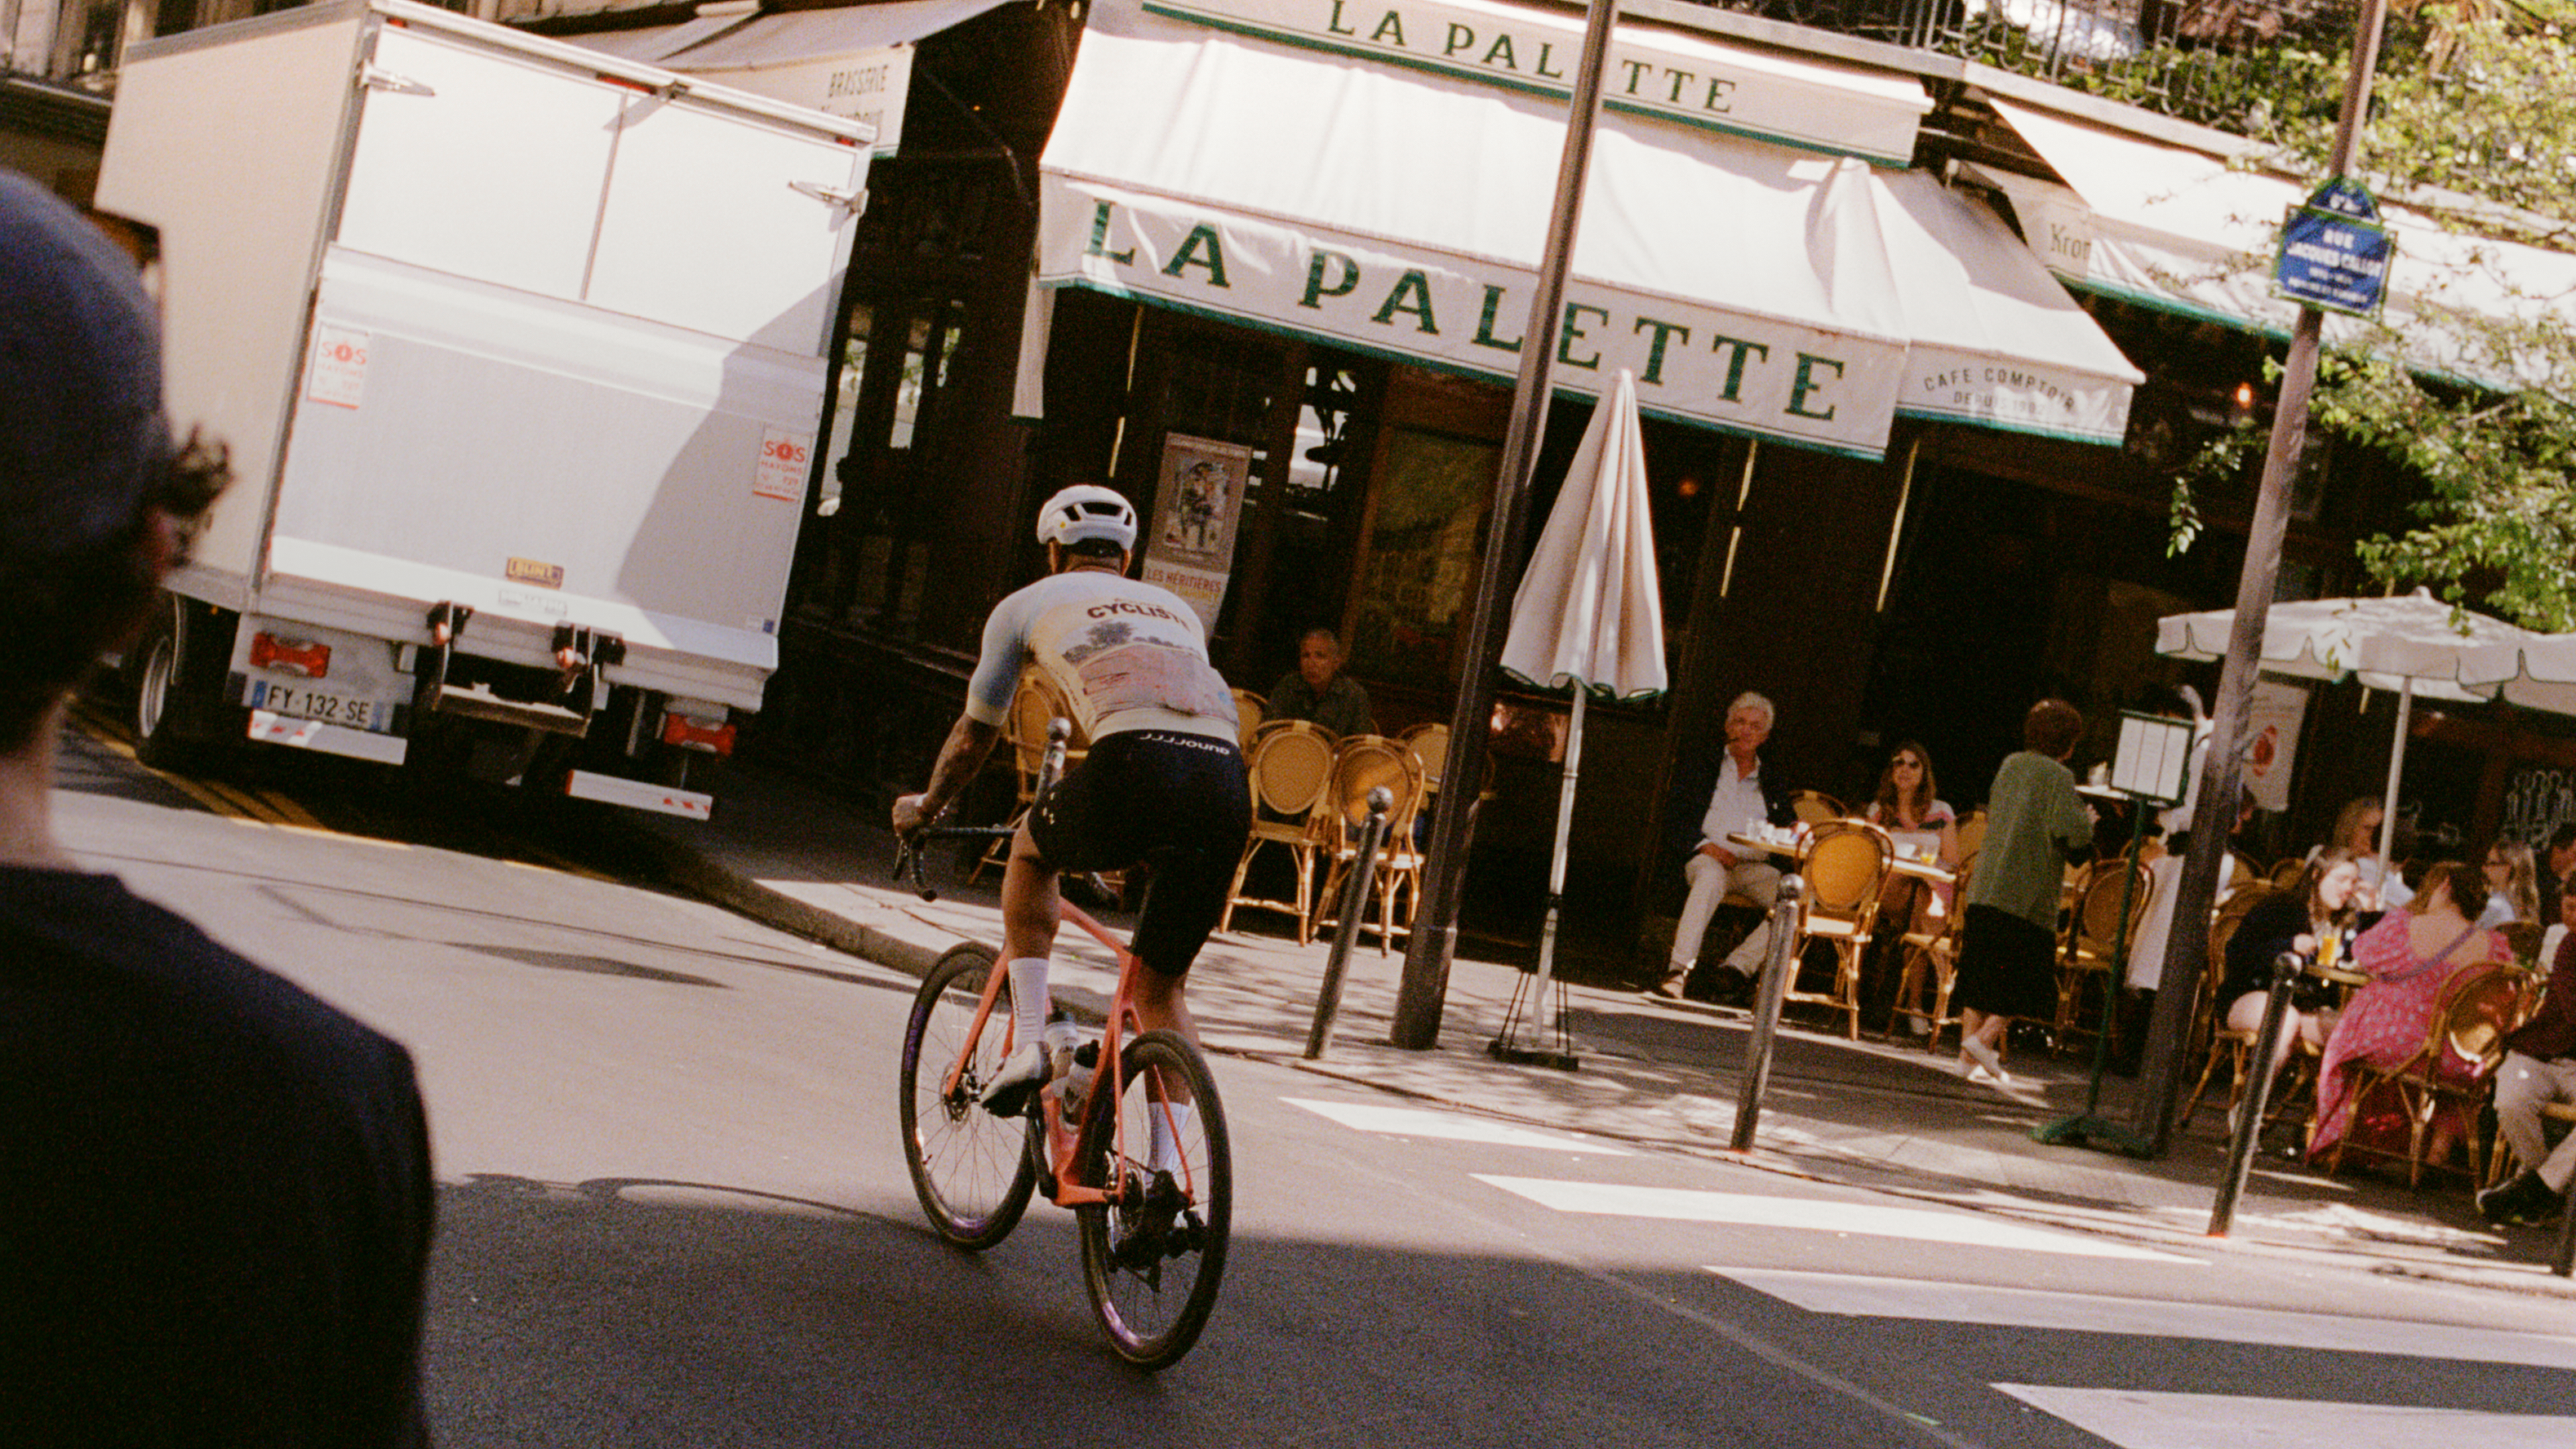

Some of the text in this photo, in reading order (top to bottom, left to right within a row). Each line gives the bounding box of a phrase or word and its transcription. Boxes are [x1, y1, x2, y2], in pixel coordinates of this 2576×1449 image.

[1328, 0, 1736, 113] LA PALTTE
[1081, 198, 1845, 422] LA PALETTE
[321, 341, 367, 365] SOS
[1923, 368, 1973, 392] CAFE
[763, 440, 805, 463] SOS
[1146, 568, 1164, 582] LES
